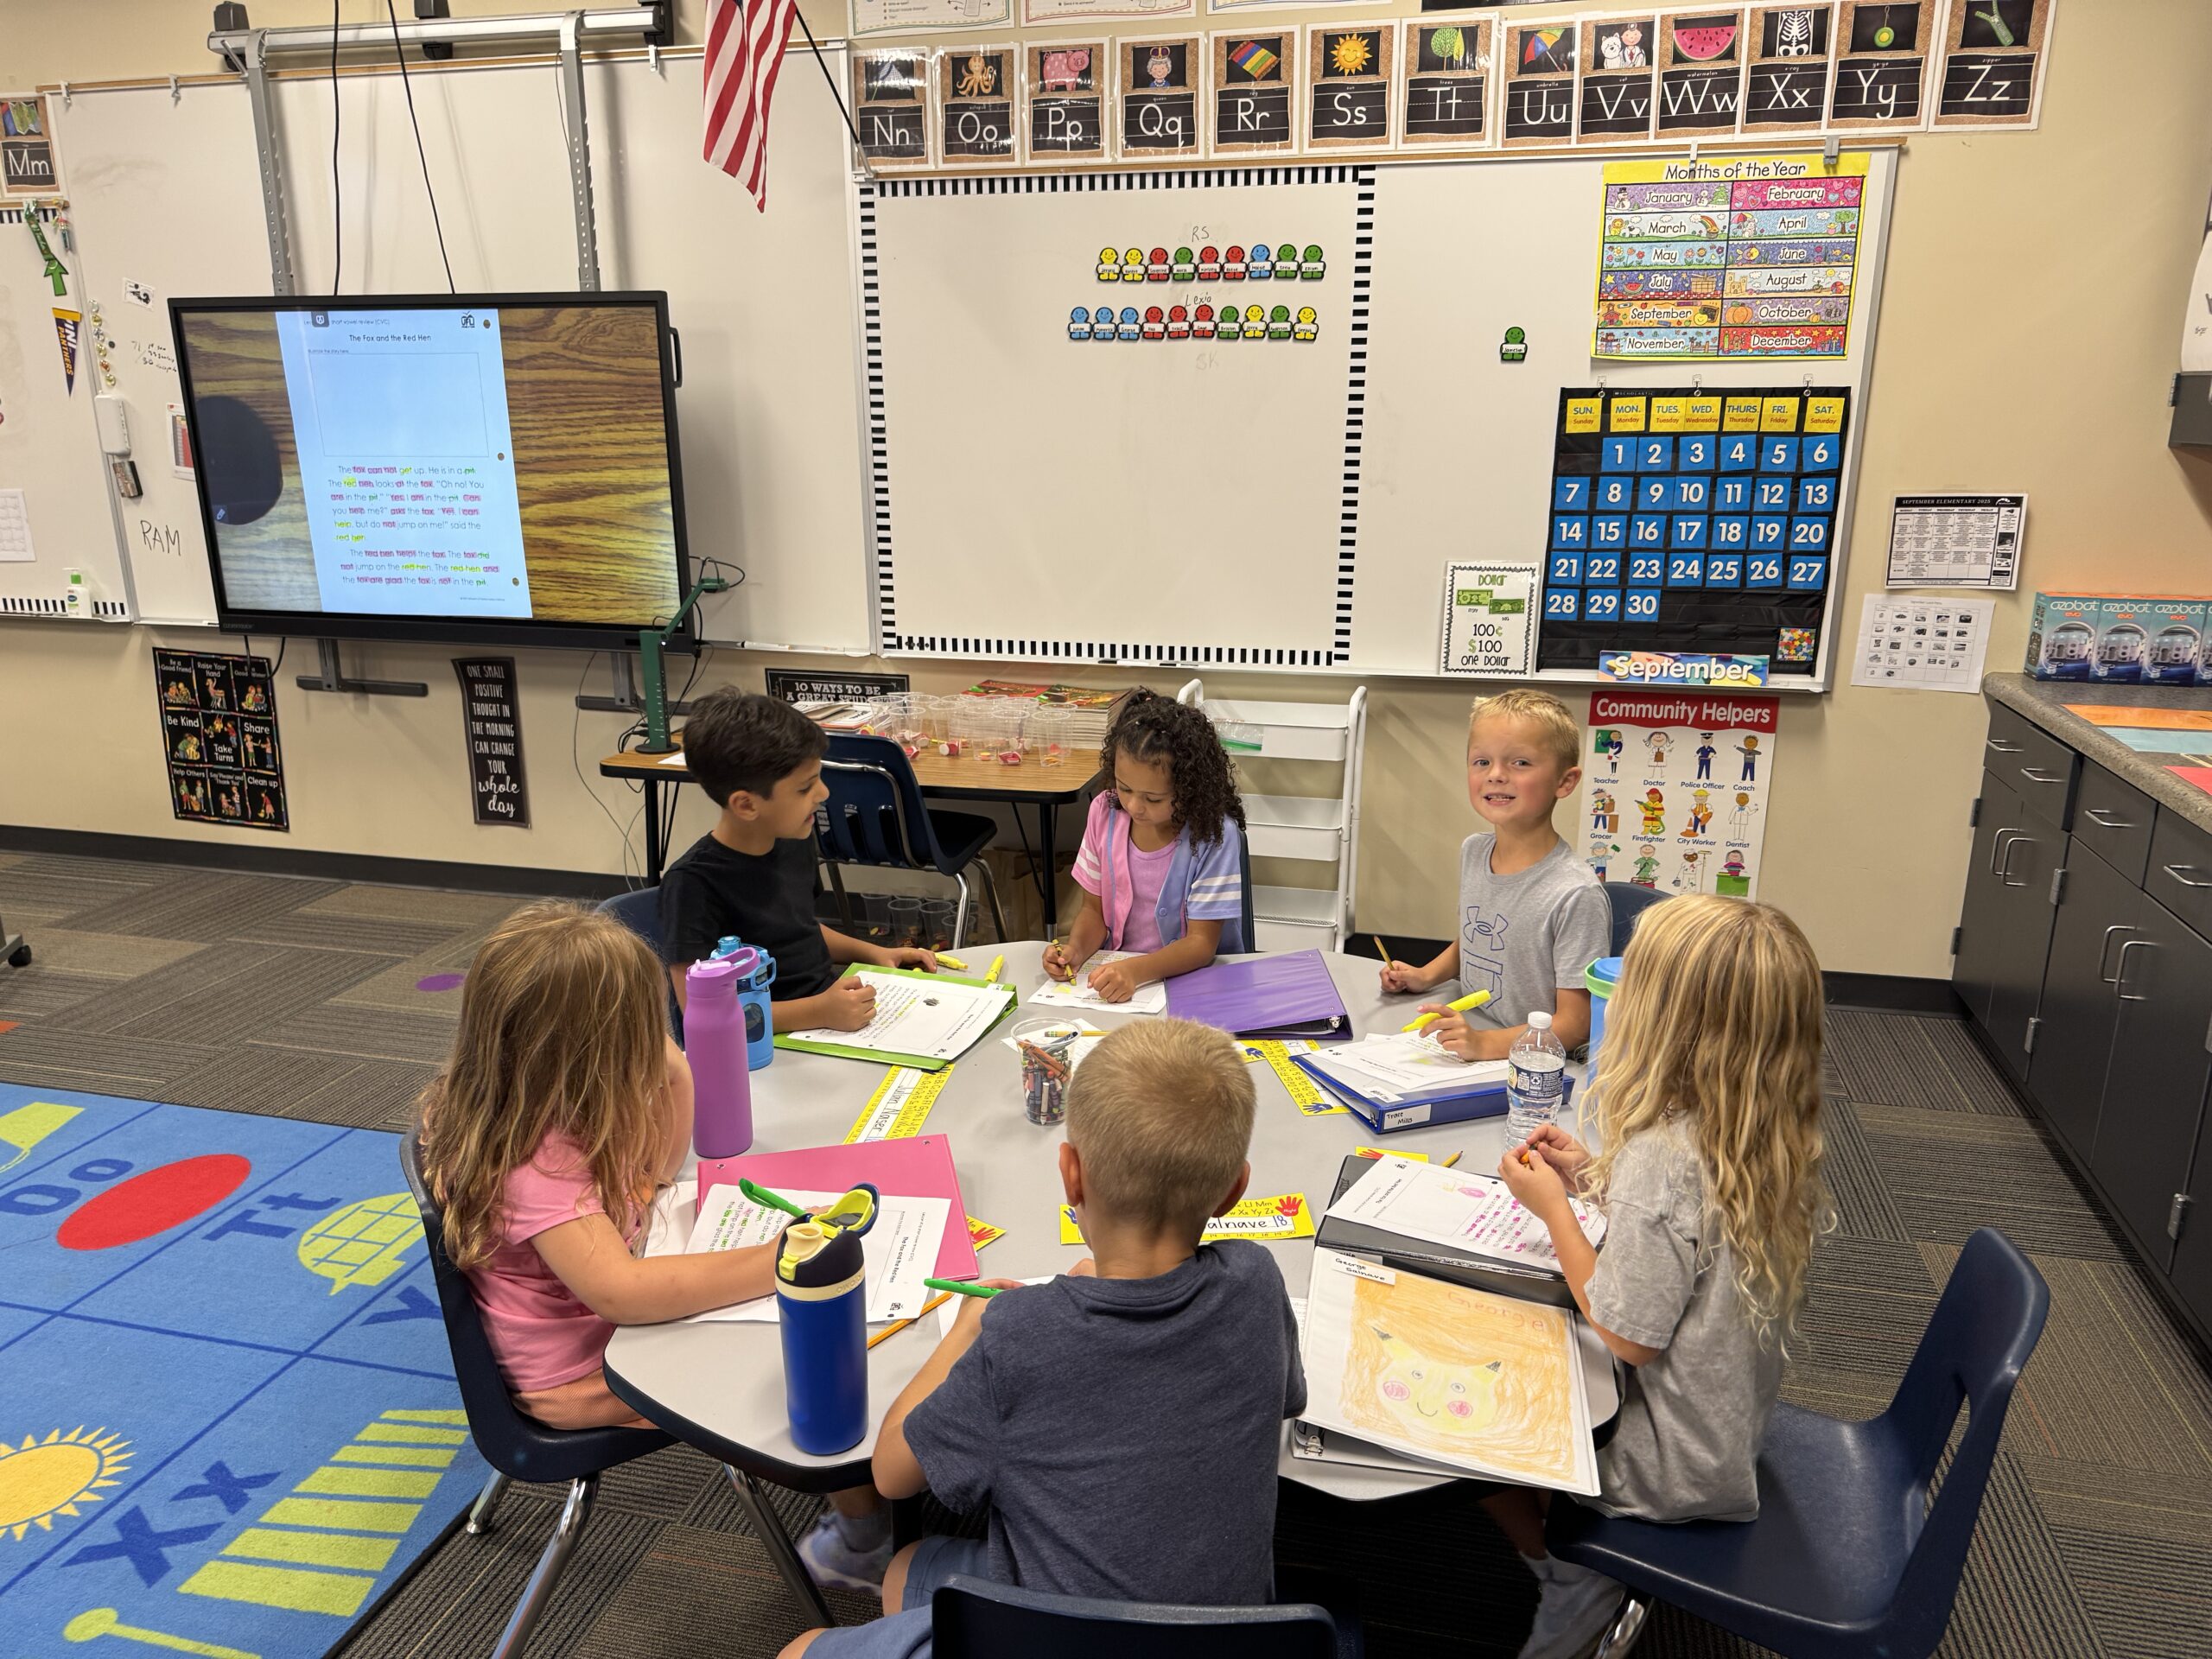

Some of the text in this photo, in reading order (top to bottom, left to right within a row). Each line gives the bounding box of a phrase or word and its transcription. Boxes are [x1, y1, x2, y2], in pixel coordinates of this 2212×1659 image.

[1963, 65, 2012, 102] Zz
[1767, 73, 1810, 110] Xx
[1857, 69, 1897, 119] Yy
[1332, 92, 1367, 125] Ss
[1427, 85, 1463, 121] Tt
[1524, 90, 1567, 124] Uu
[1597, 85, 1649, 119] Vv
[1237, 98, 1270, 130] Rr
[874, 115, 910, 146] Nn
[957, 111, 998, 143] Oo
[1047, 107, 1084, 152] Pp
[1140, 104, 1185, 148] Qq
[8, 149, 50, 175] Mm
[1665, 162, 1806, 180] Months of the Year
[1645, 192, 1693, 205] January
[1768, 188, 1825, 201] February
[1648, 222, 1687, 234] March
[1778, 217, 1807, 231] April
[1192, 226, 1210, 242] RS
[1653, 249, 1678, 263] May
[1778, 249, 1806, 260] June
[1649, 275, 1672, 290] July
[1766, 275, 1808, 289] August
[1630, 308, 1692, 322] September
[1758, 306, 1812, 318] October
[417, 334, 432, 342] Hen
[1627, 338, 1685, 350] November
[1751, 335, 1813, 347] December
[57, 326, 74, 376] PANTHERS
[1573, 405, 1595, 416] SUN.
[1615, 404, 1642, 415] MON.
[1656, 405, 1681, 415] TUES.
[1691, 405, 1714, 415] WED.
[1726, 404, 1759, 414] THURS.
[1771, 405, 1789, 415] FRI.
[1814, 405, 1835, 415] SAT.
[1572, 417, 1594, 426] Sunday
[1616, 416, 1640, 425] Monday
[1656, 416, 1680, 425] Tuesday
[1685, 416, 1719, 425] Wednesday
[1728, 416, 1755, 424] Thursday
[1770, 416, 1788, 425] Friday
[1809, 416, 1837, 425] Saturday
[1614, 442, 1828, 465] 1 2 3 4 5 6
[1566, 484, 1828, 505] 7 8 9 10 11 12 13
[450, 521, 467, 531] said
[467, 521, 482, 531] the
[1559, 521, 1824, 543] 14 15 16 17 18 19 20
[140, 519, 181, 556] RAM
[1555, 558, 1822, 582] 21 22 23 24 25 26 27
[1548, 594, 1657, 615] 28 29 30
[1468, 639, 1503, 653] $100
[467, 665, 505, 679] ONE SMALL
[1613, 655, 1754, 682] September
[474, 683, 503, 698] POSITIVE
[795, 681, 880, 696] 10 WAYS TO BE
[786, 691, 795, 701] A
[798, 692, 836, 702] GREAT
[472, 702, 511, 717] THOUGHT IN
[1595, 697, 1770, 727] Community Helpers
[167, 716, 200, 728] Be Kind
[243, 721, 270, 734] Share
[471, 721, 514, 737] THE MORNING
[213, 744, 232, 753] Take
[474, 741, 515, 756] CAN CHANGE
[213, 752, 234, 762] Turns
[173, 768, 206, 778] Help Others
[487, 759, 507, 774] YOUR
[247, 776, 278, 788] Clean up
[478, 774, 520, 794] whole
[1732, 784, 1755, 792] Coach
[487, 793, 516, 817] day
[1631, 835, 1666, 844] Firefighter
[1676, 837, 1717, 847] City Worker
[1726, 840, 1750, 849] Dentist
[201, 1191, 343, 1242] Tt
[1207, 1217, 1268, 1229] alnave
[1335, 1257, 1366, 1271] George
[1345, 1267, 1386, 1281] Salnave
[1447, 1291, 1544, 1331] George
[60, 1459, 283, 1587] Xx
